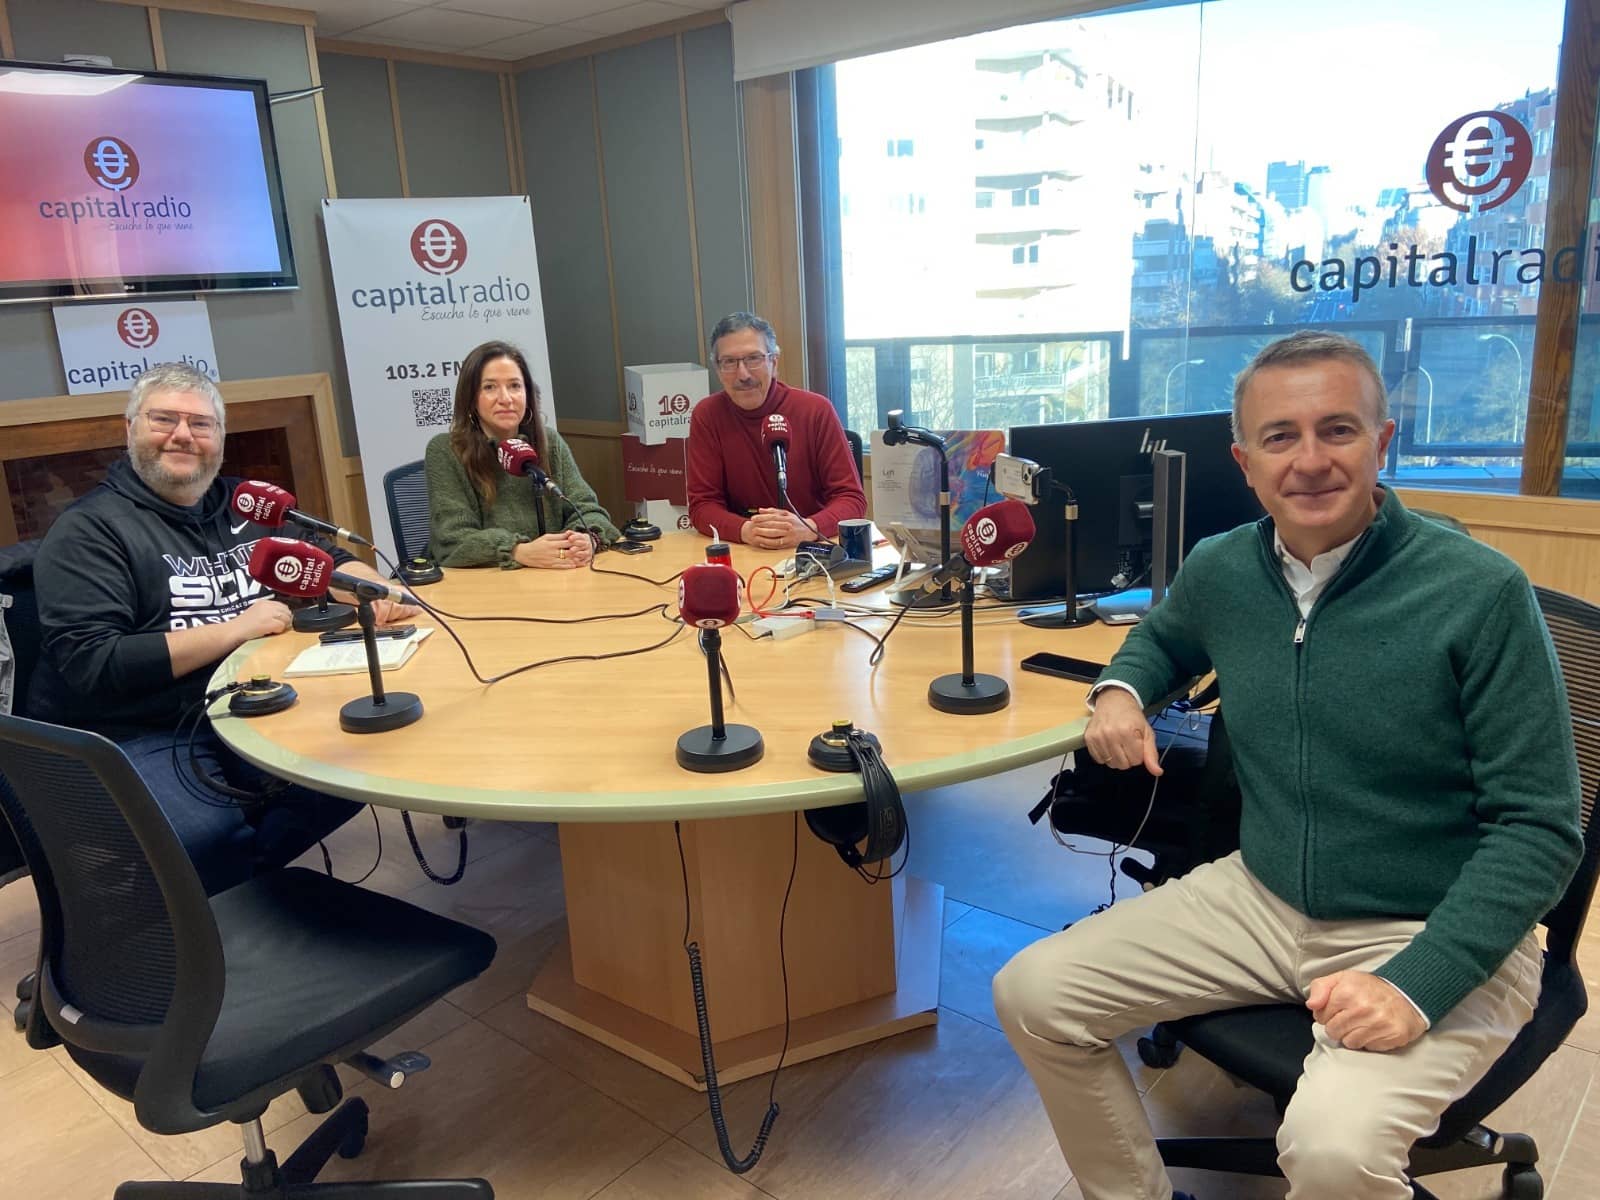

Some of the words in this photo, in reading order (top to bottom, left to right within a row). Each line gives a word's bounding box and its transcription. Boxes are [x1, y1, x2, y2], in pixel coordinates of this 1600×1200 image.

[39, 195, 191, 224] capitalradio
[352, 276, 531, 314] capitalradio
[421, 302, 464, 321] Escucha
[468, 304, 480, 319] lo
[483, 308, 502, 323] que
[385, 363, 437, 380] 103.2
[254, 496, 266, 521] capital
[967, 523, 985, 556] capital
[299, 557, 316, 591] capital
